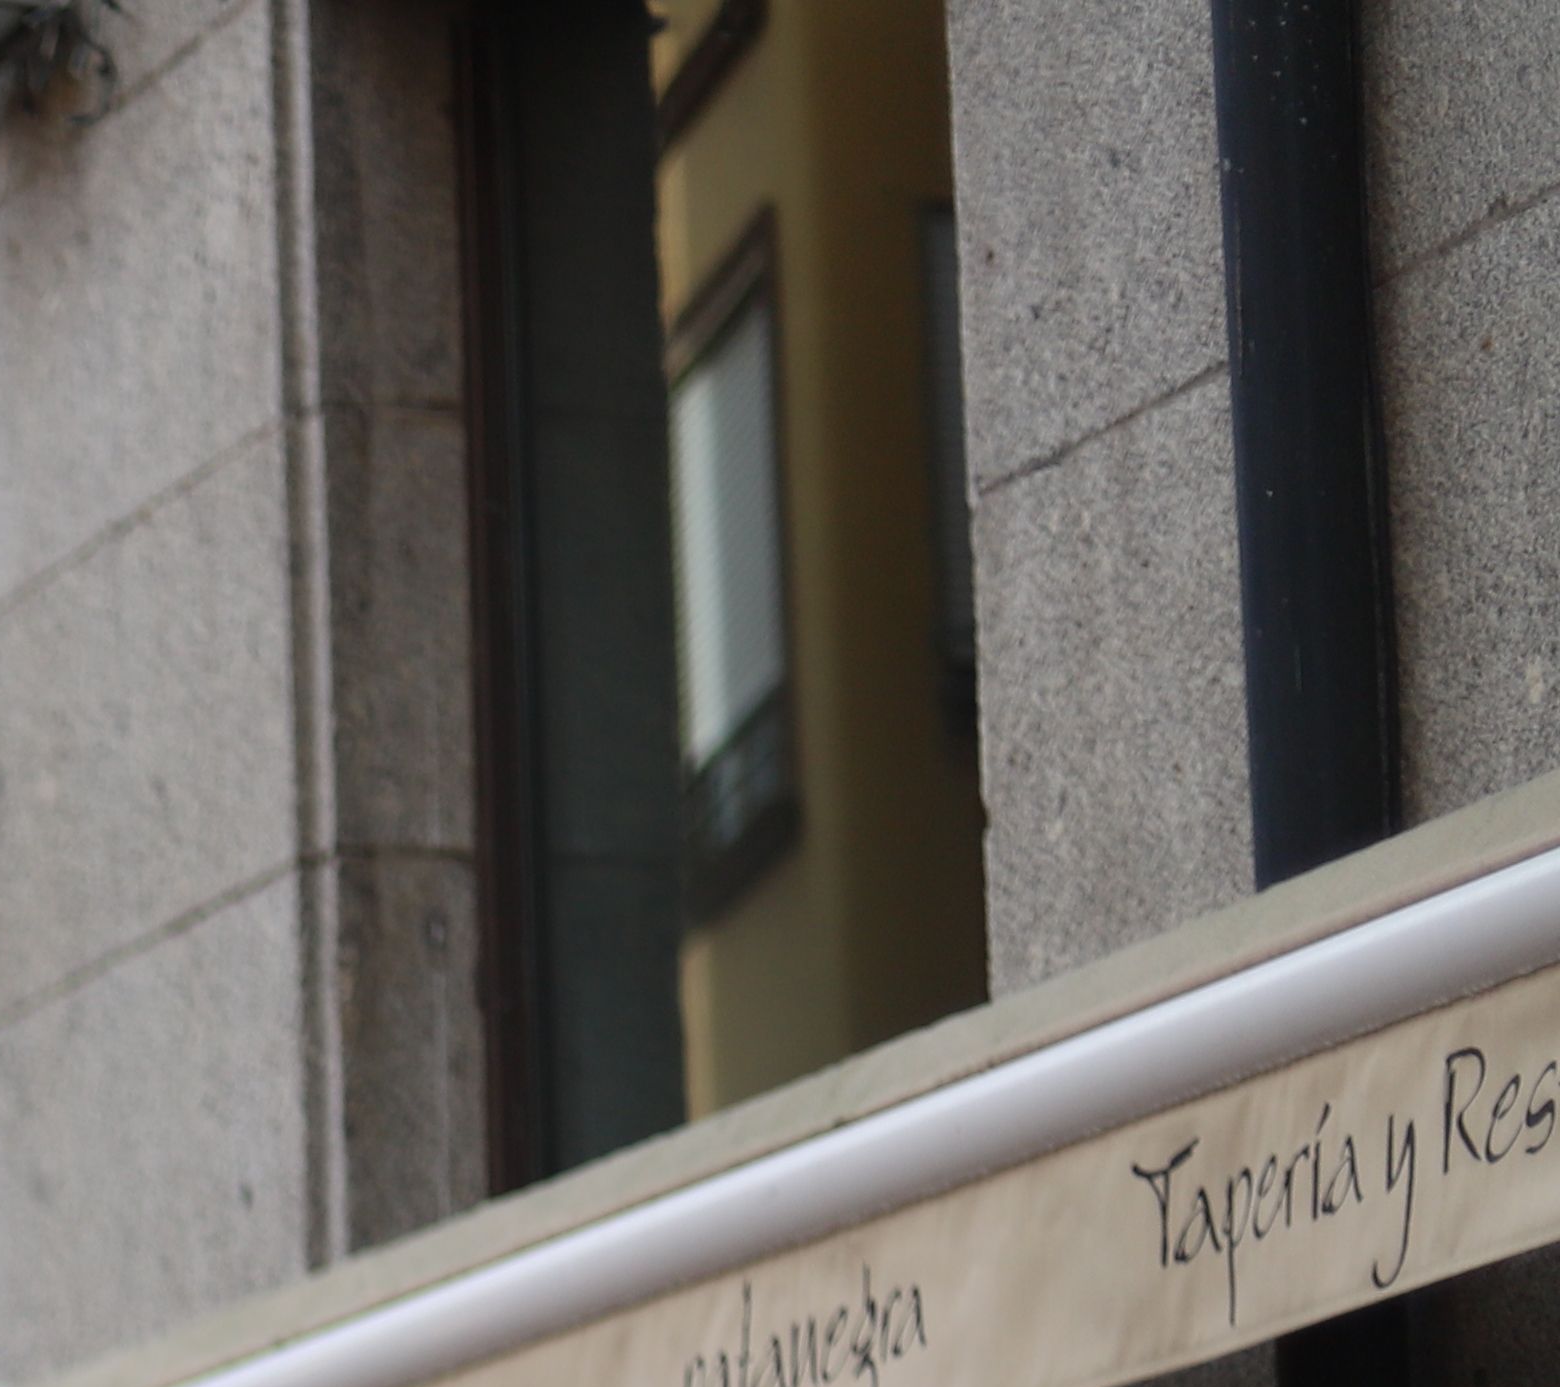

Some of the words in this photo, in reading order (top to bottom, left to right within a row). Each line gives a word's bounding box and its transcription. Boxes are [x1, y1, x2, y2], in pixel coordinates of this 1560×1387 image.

[1131, 1102, 1364, 1328] Tapería
[1371, 1112, 1416, 1289] y
[1442, 1046, 1560, 1176] Res
